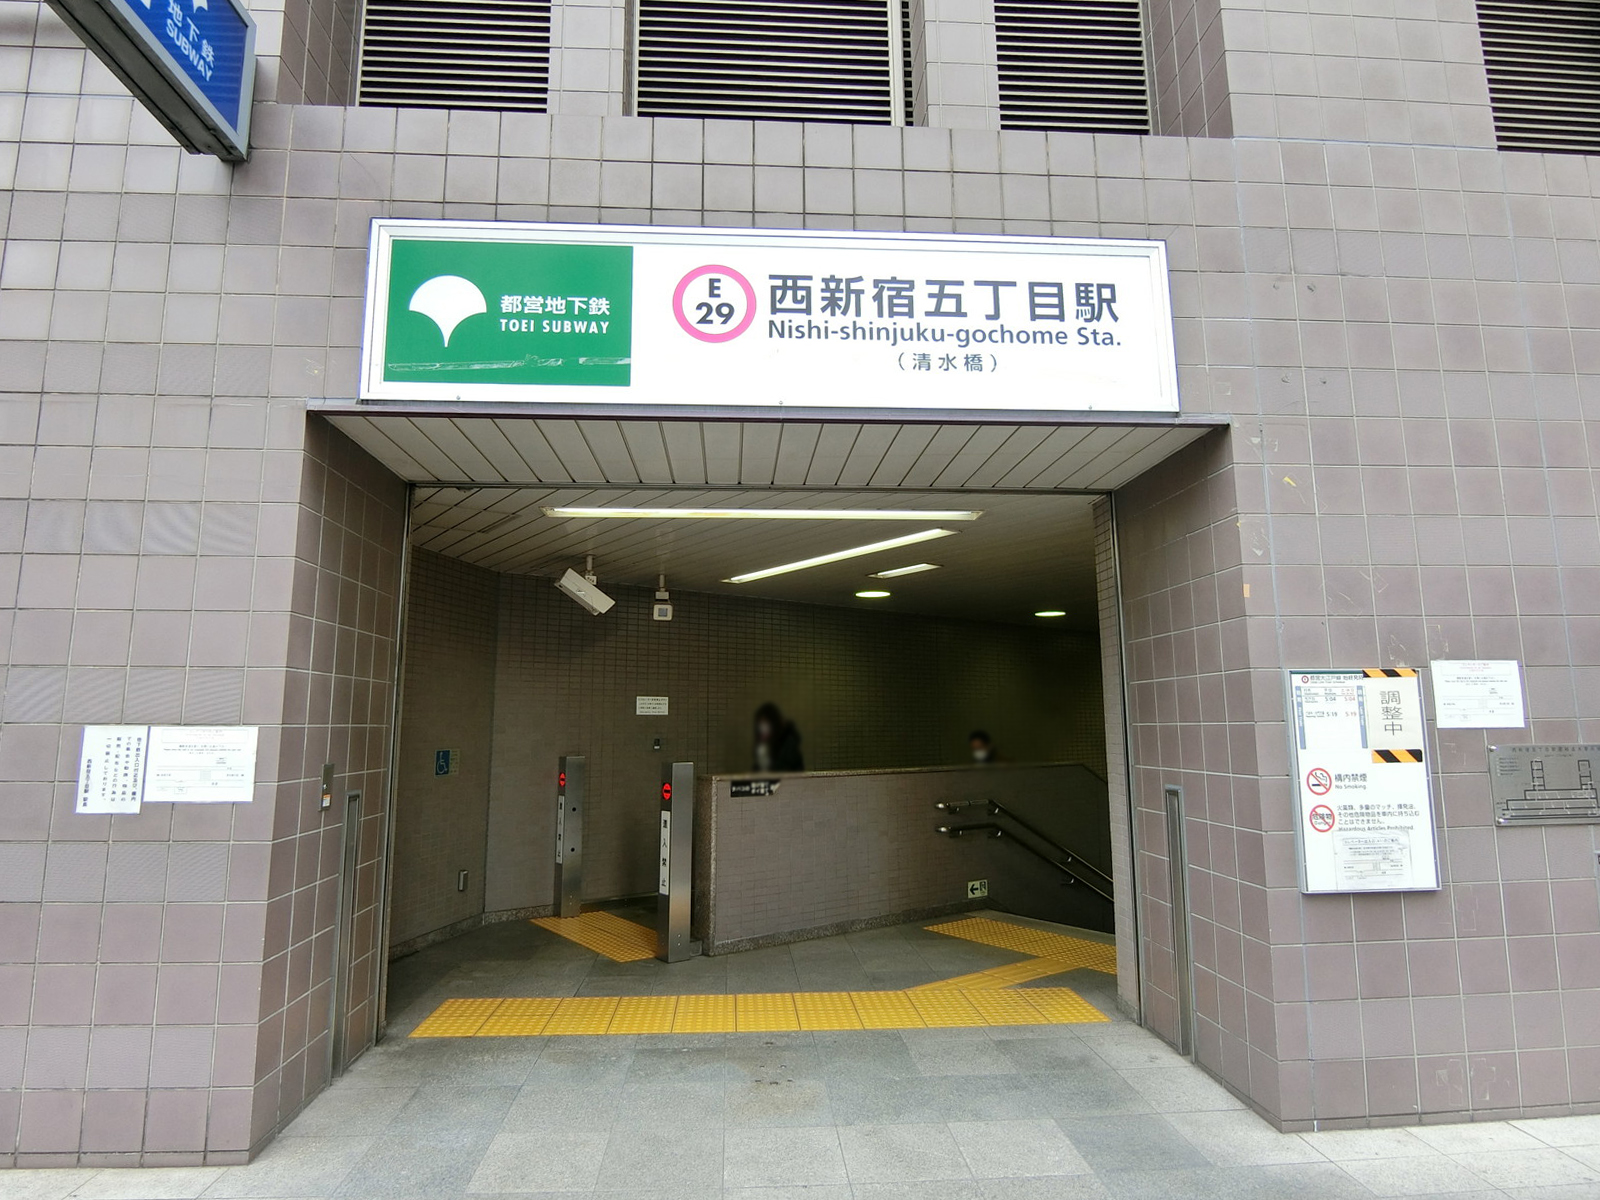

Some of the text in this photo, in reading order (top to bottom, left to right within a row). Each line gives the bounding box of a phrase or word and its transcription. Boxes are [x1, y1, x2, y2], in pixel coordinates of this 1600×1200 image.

[168, 0, 214, 68] 地下鉄
[166, 18, 212, 82] SUBWAY
[708, 278, 721, 298] E
[768, 274, 1119, 323] 西新宿五丁目駅
[500, 295, 611, 316] 都営地下鉄
[695, 302, 735, 324] 29
[499, 319, 610, 334] TOEI SUBWAY
[768, 319, 1121, 348] Nishi-shinjuku-gochome Sta.
[1380, 690, 1403, 736] 調整中
[1334, 774, 1367, 782] 構内禁煙
